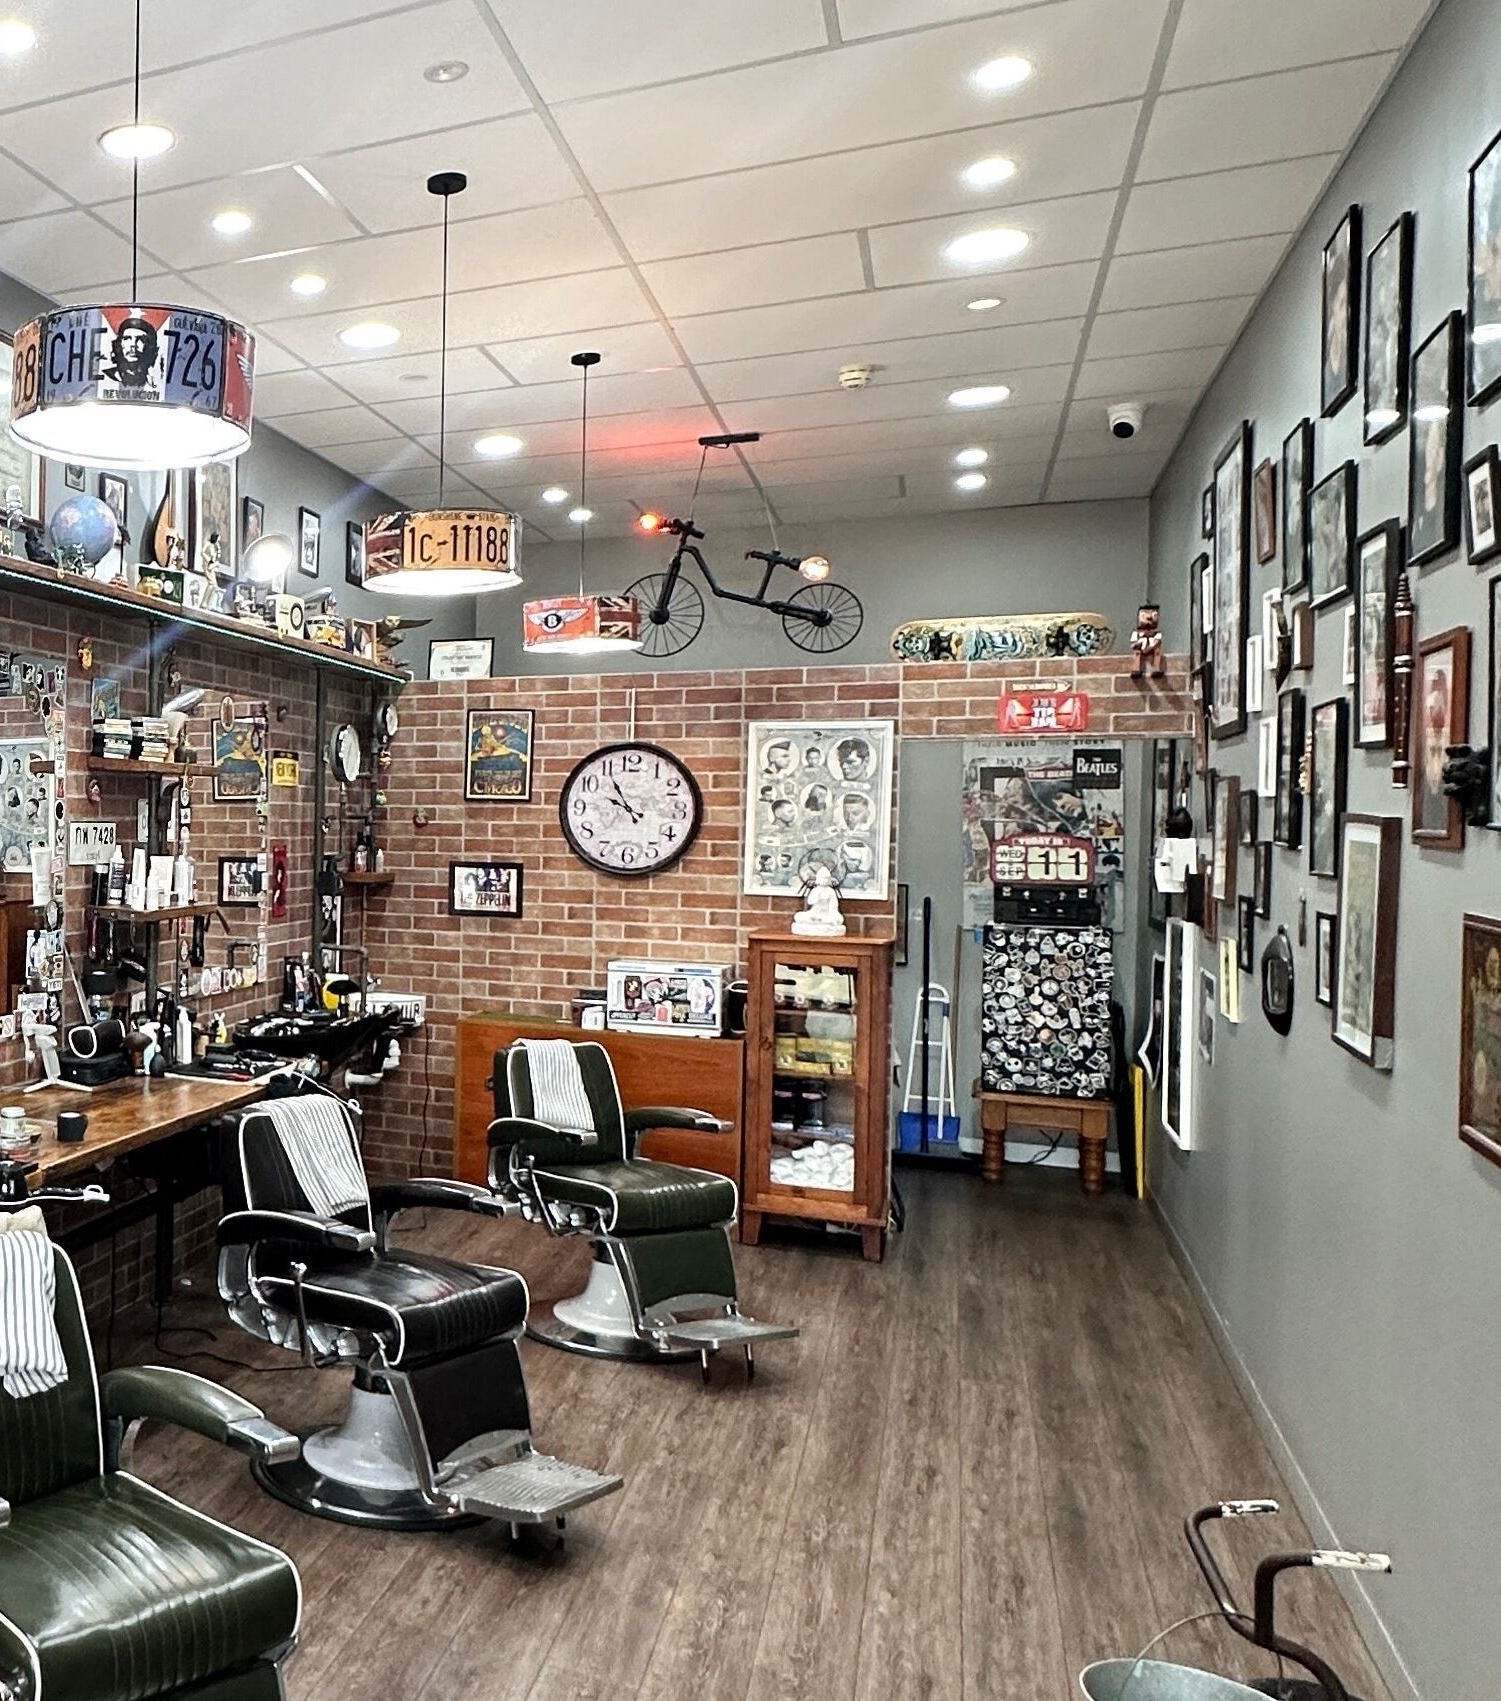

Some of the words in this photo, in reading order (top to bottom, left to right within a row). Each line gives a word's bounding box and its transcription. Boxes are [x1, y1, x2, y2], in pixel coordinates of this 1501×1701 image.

[49, 327, 107, 385] CHE
[164, 329, 216, 391] 726
[602, 759, 613, 777] 11
[622, 754, 642, 772] 12
[654, 761, 660, 779] 1
[1077, 757, 1118, 777] BEATLES
[581, 774, 598, 793] 10
[666, 777, 681, 796] 2
[573, 799, 586, 816] 9
[672, 801, 687, 820] 3
[93, 826, 114, 845] 7428
[580, 821, 594, 839] 8
[661, 825, 677, 842] 4
[599, 840, 611, 857] 7
[621, 847, 634, 864] 6
[645, 841, 659, 859] 5
[999, 848, 1024, 859] WED
[999, 865, 1023, 876] SEP
[475, 892, 511, 907] ZEPPELIN
